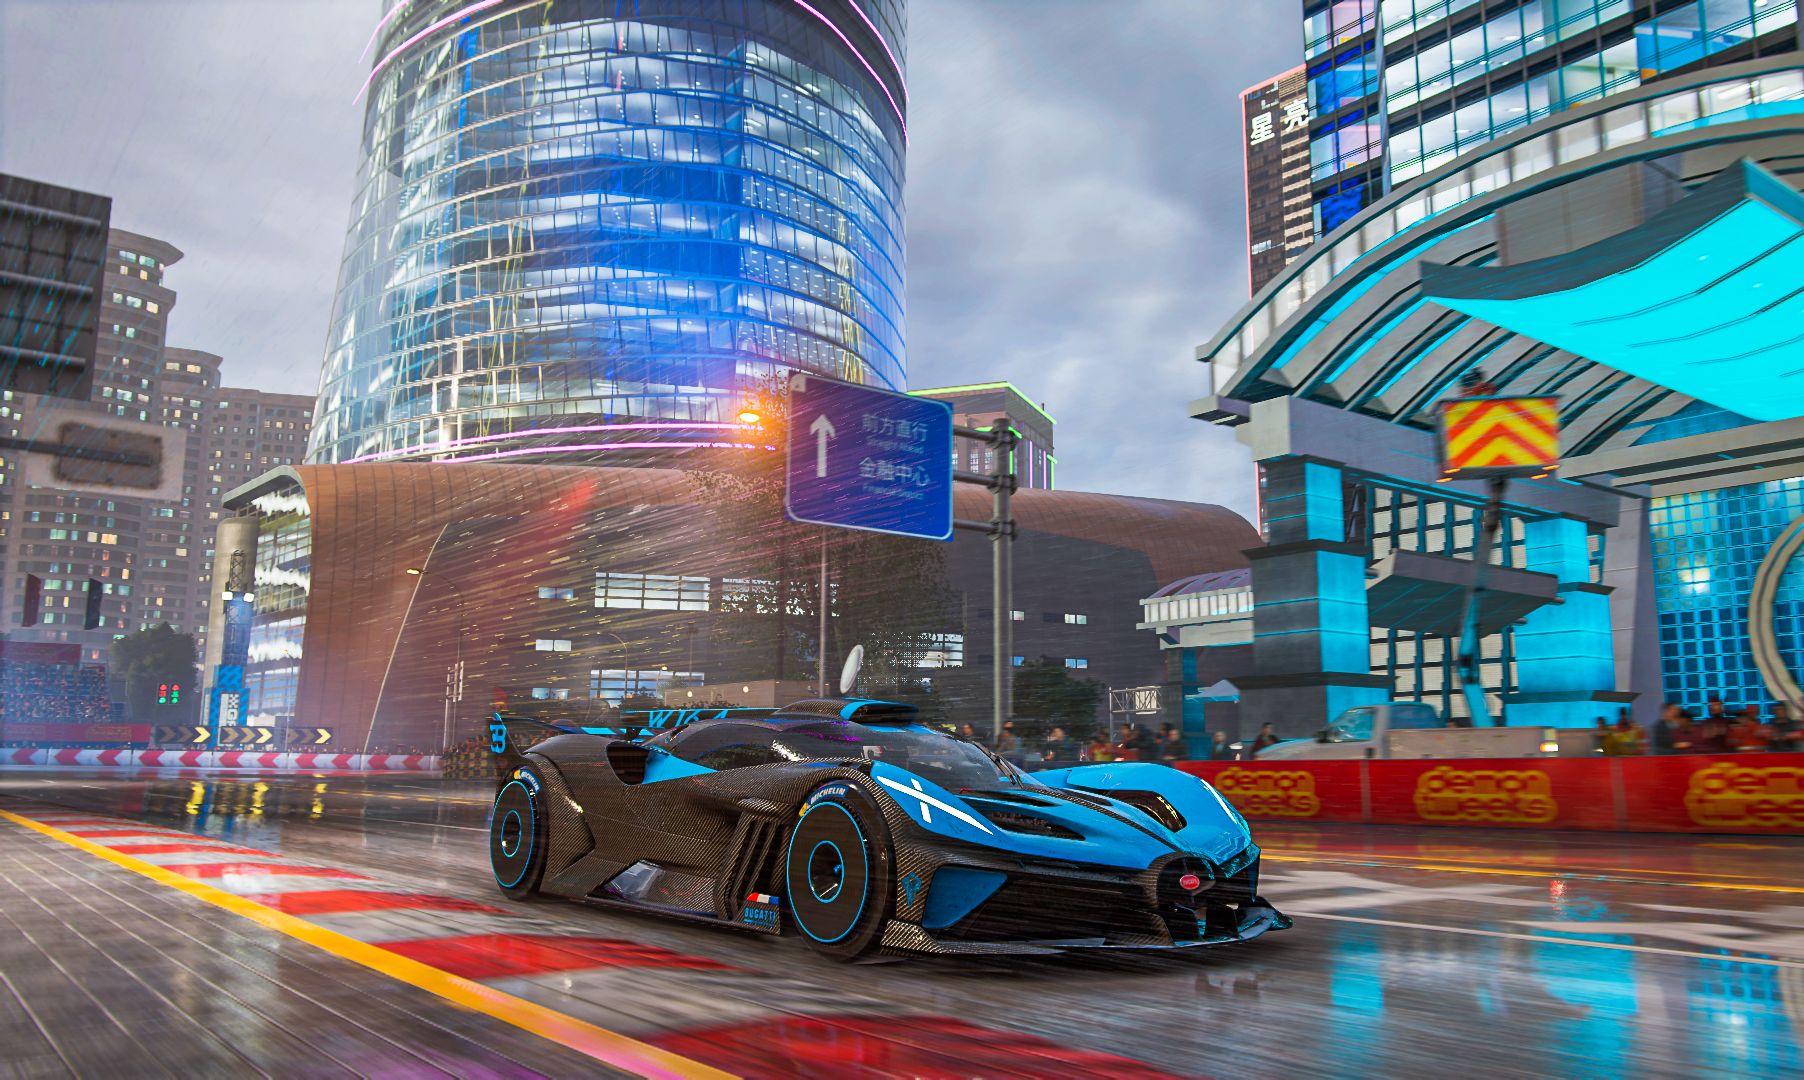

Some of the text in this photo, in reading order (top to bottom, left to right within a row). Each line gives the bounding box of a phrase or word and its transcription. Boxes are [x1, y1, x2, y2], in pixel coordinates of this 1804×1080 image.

[861, 413, 928, 442] 前方直行
[859, 457, 930, 486] 金融中心
[1418, 766, 1551, 796] demon
[1688, 762, 1804, 797] dem
[810, 786, 846, 805] MICHELIN
[744, 907, 777, 921] BUGATTI
